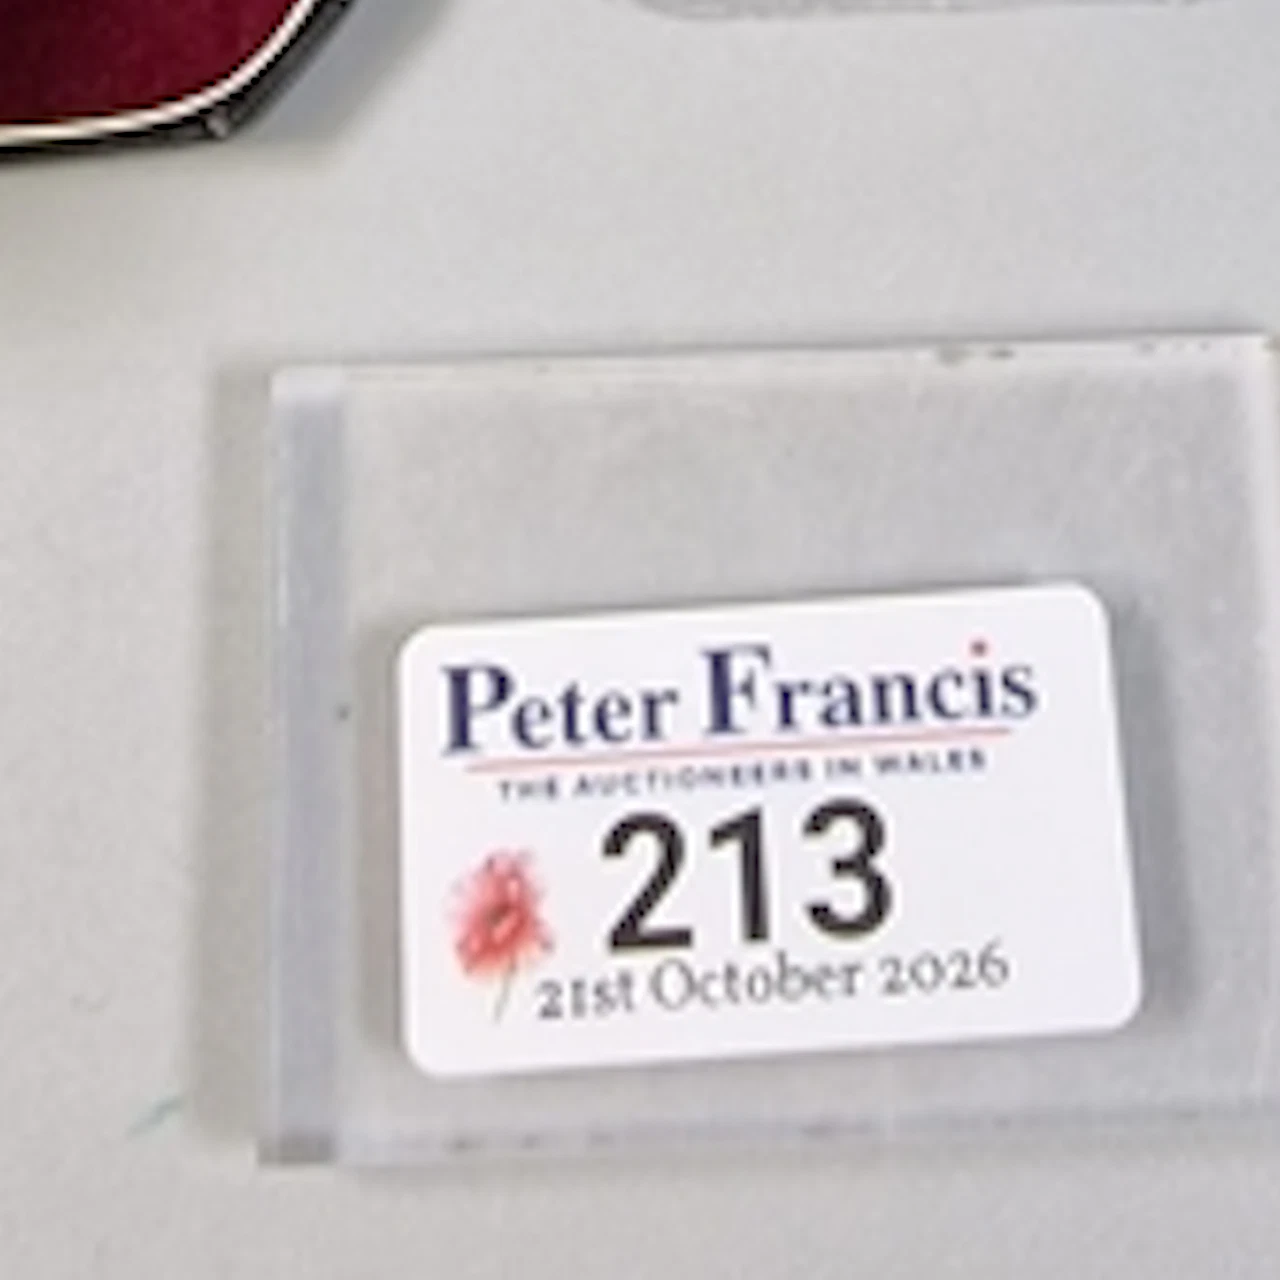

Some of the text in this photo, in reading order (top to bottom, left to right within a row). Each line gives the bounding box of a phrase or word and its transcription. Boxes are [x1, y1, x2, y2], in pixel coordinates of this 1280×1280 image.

[440, 638, 1039, 758] Peter Francis
[498, 747, 987, 800] THE AUCTIONEERS IN WALES
[601, 796, 892, 954] 213
[537, 938, 1010, 1020] 21st October 2026
